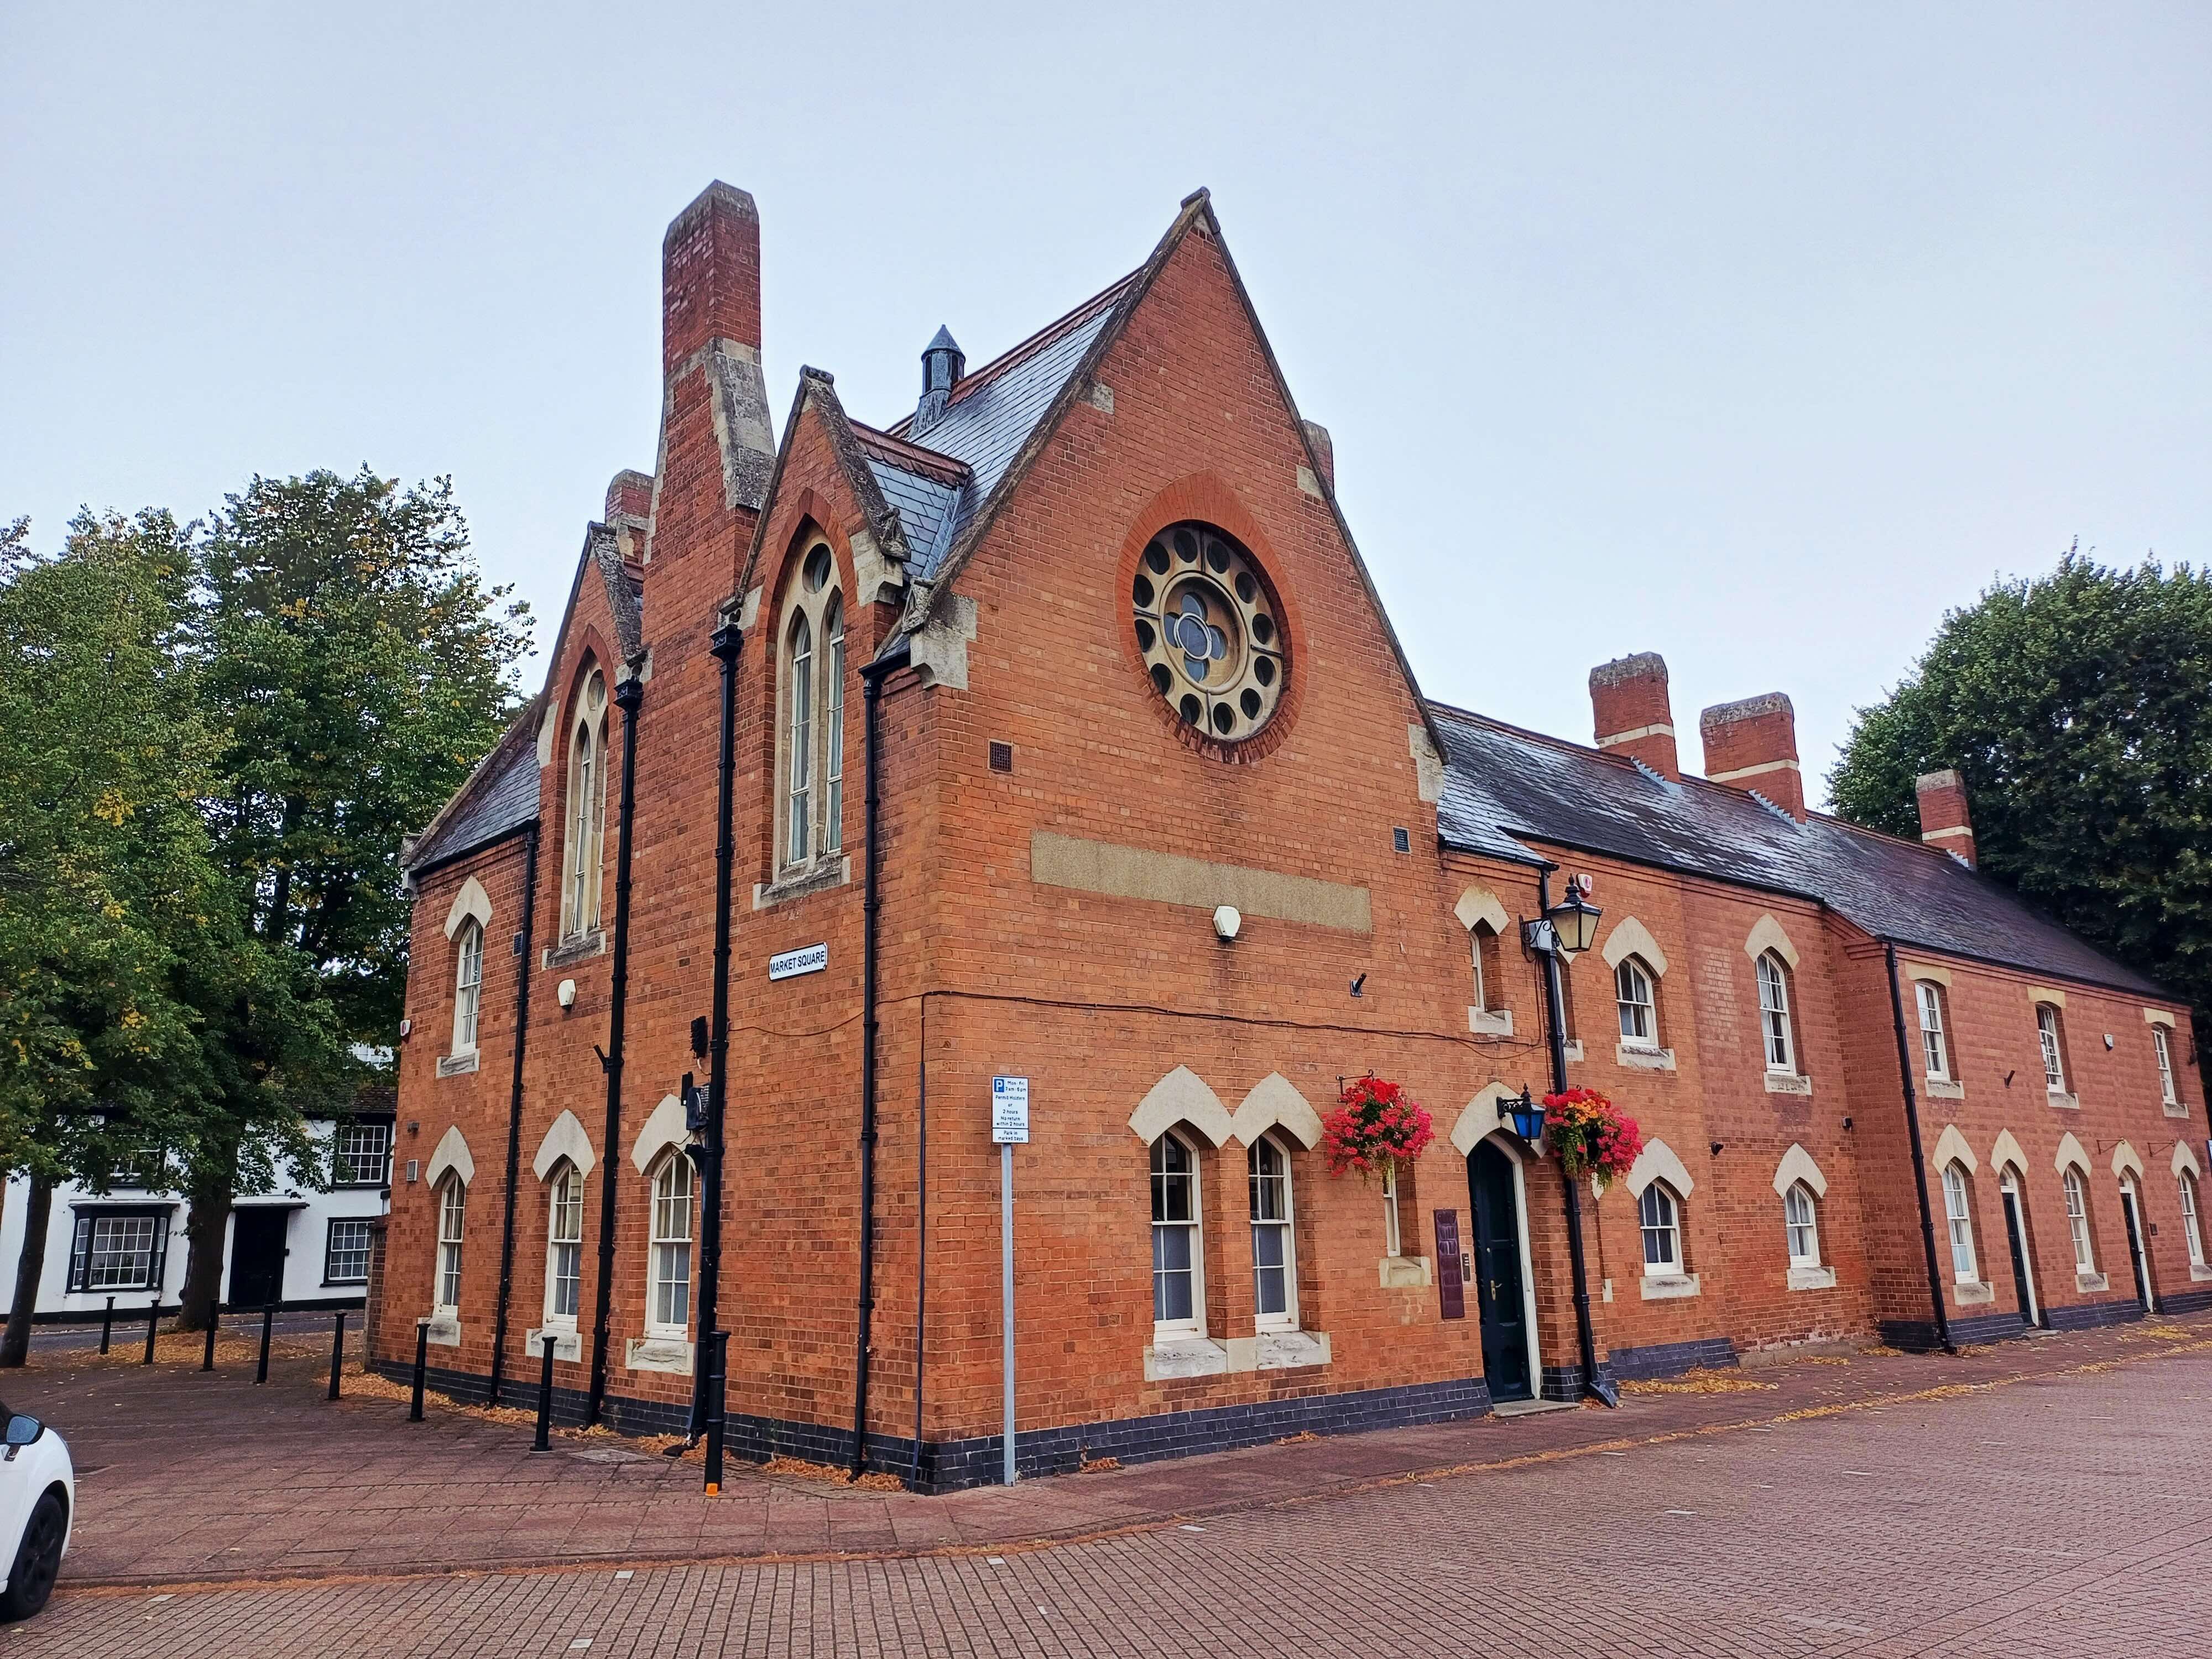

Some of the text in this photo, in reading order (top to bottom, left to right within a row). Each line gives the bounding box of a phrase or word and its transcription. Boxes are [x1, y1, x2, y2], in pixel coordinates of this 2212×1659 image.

[770, 951, 825, 973] MARKET SQUARE
[996, 1080, 1003, 1091] P
